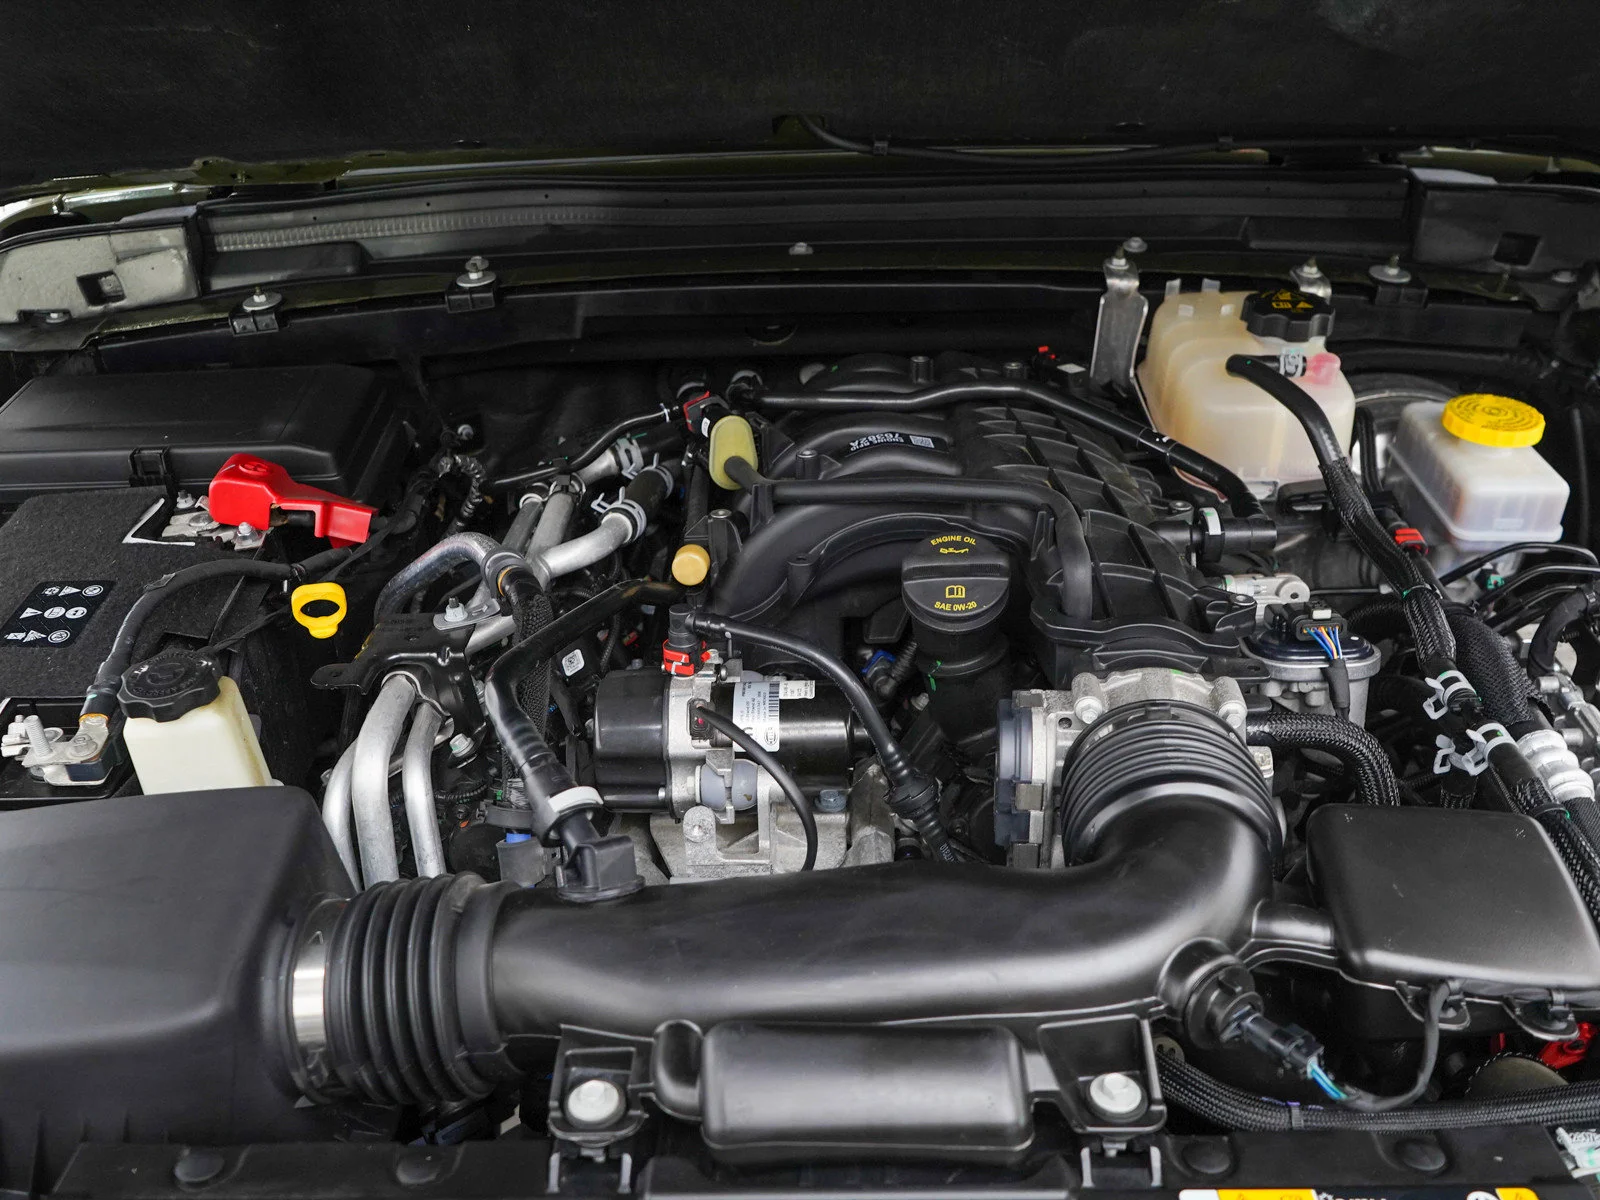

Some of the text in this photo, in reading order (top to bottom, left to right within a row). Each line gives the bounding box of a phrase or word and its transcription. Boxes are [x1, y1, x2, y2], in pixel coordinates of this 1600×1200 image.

[872, 436, 904, 445] ENGINE
[930, 535, 976, 546] ENGINE OIL
[934, 600, 977, 611] SAE 0W-20
